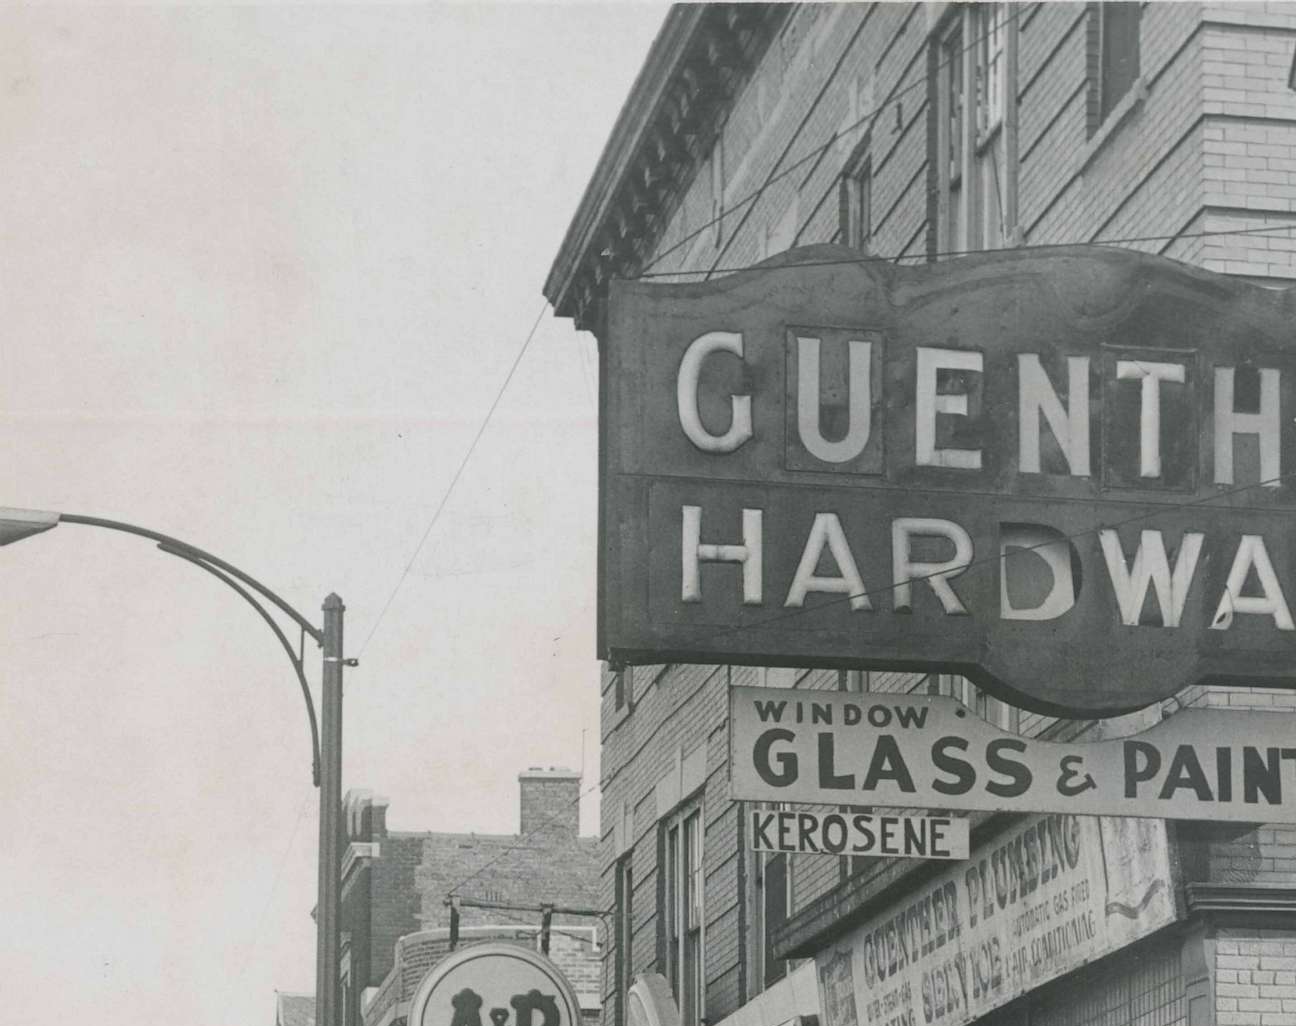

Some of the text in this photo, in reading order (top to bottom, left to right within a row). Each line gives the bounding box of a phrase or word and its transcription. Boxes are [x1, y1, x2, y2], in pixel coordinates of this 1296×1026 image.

[753, 700, 929, 729] WINDOW
[752, 727, 1032, 798] GLASS
[1056, 755, 1098, 797] &
[753, 812, 951, 857] KEROSENE
[864, 812, 1081, 989] GUENTHER PLUMBING
[921, 937, 1002, 1024] SERVICE
